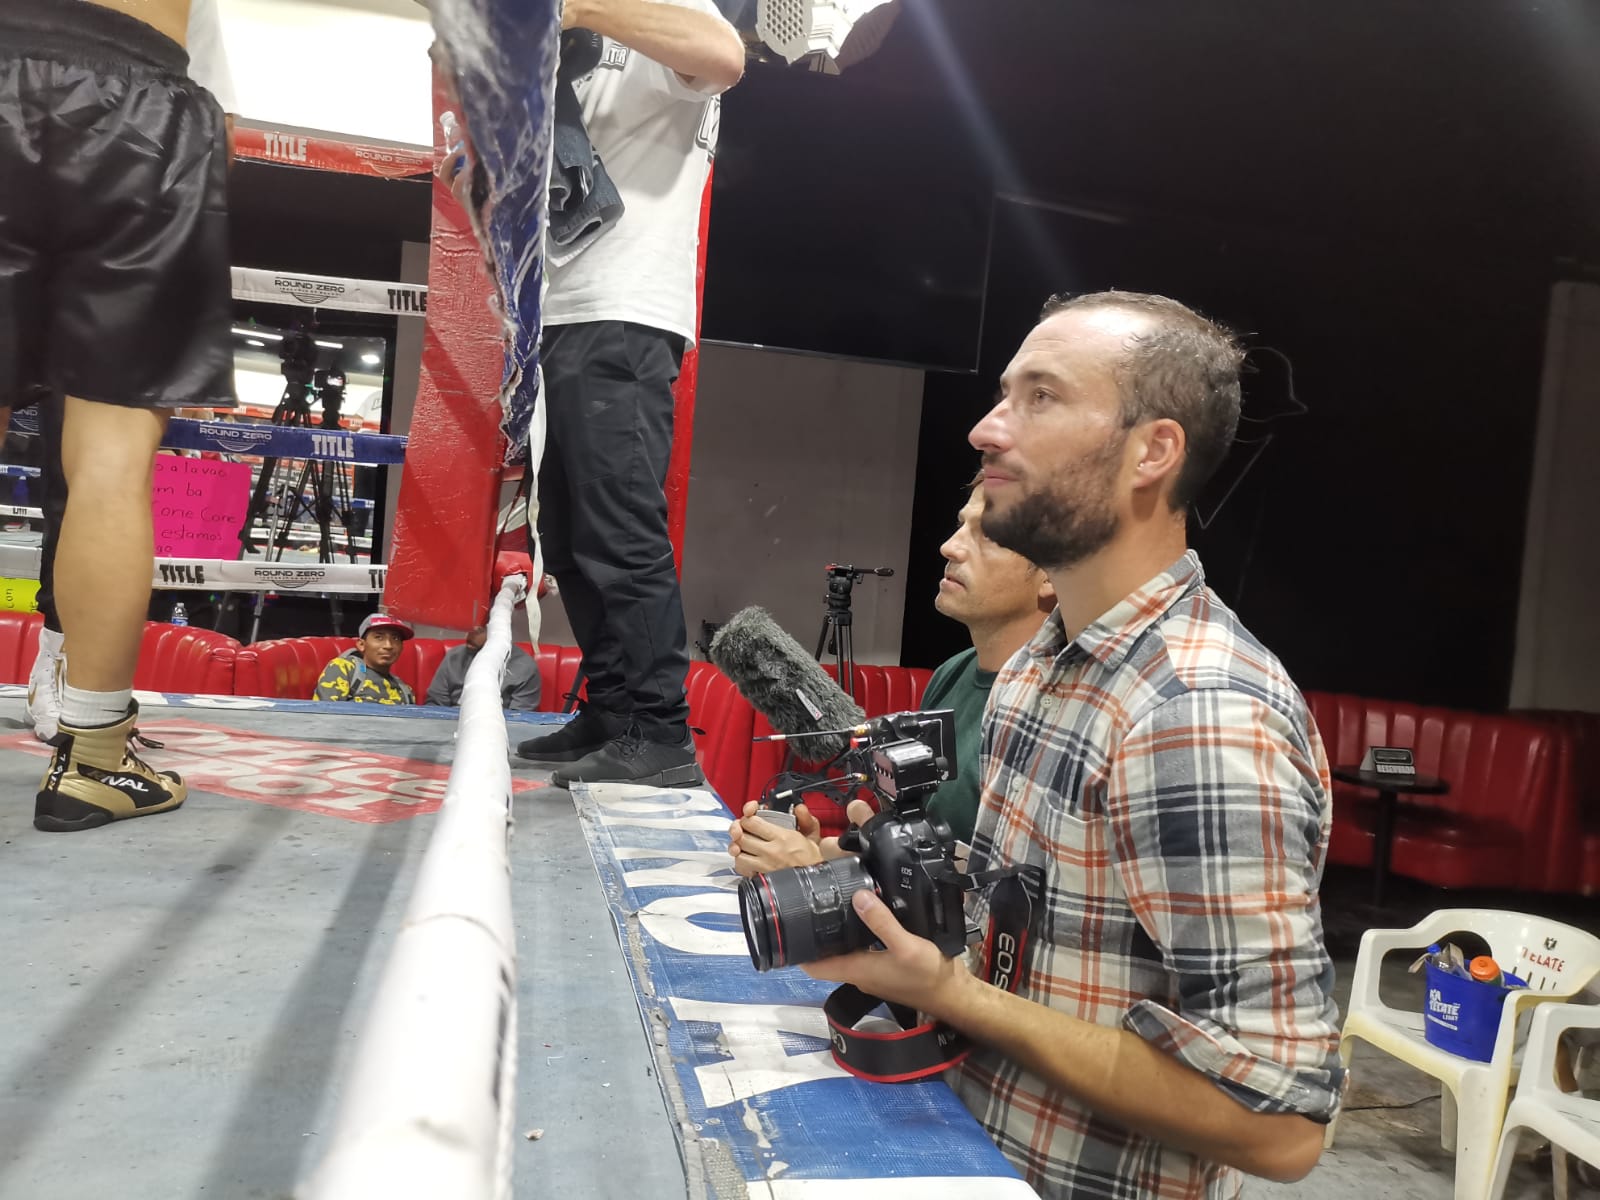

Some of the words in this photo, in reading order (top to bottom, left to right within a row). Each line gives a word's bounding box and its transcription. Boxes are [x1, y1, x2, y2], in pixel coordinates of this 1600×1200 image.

[264, 132, 307, 162] TITLE
[355, 150, 393, 162] ROUND
[274, 279, 312, 290] ROUND
[316, 284, 345, 293] ZERO
[387, 288, 427, 312] TITLE
[199, 428, 240, 438] ROUND
[242, 432, 272, 441] ZERO
[311, 434, 355, 458] TITLE
[186, 480, 202, 496] ba
[159, 564, 205, 584] TITLE
[994, 932, 1015, 991] EOS
